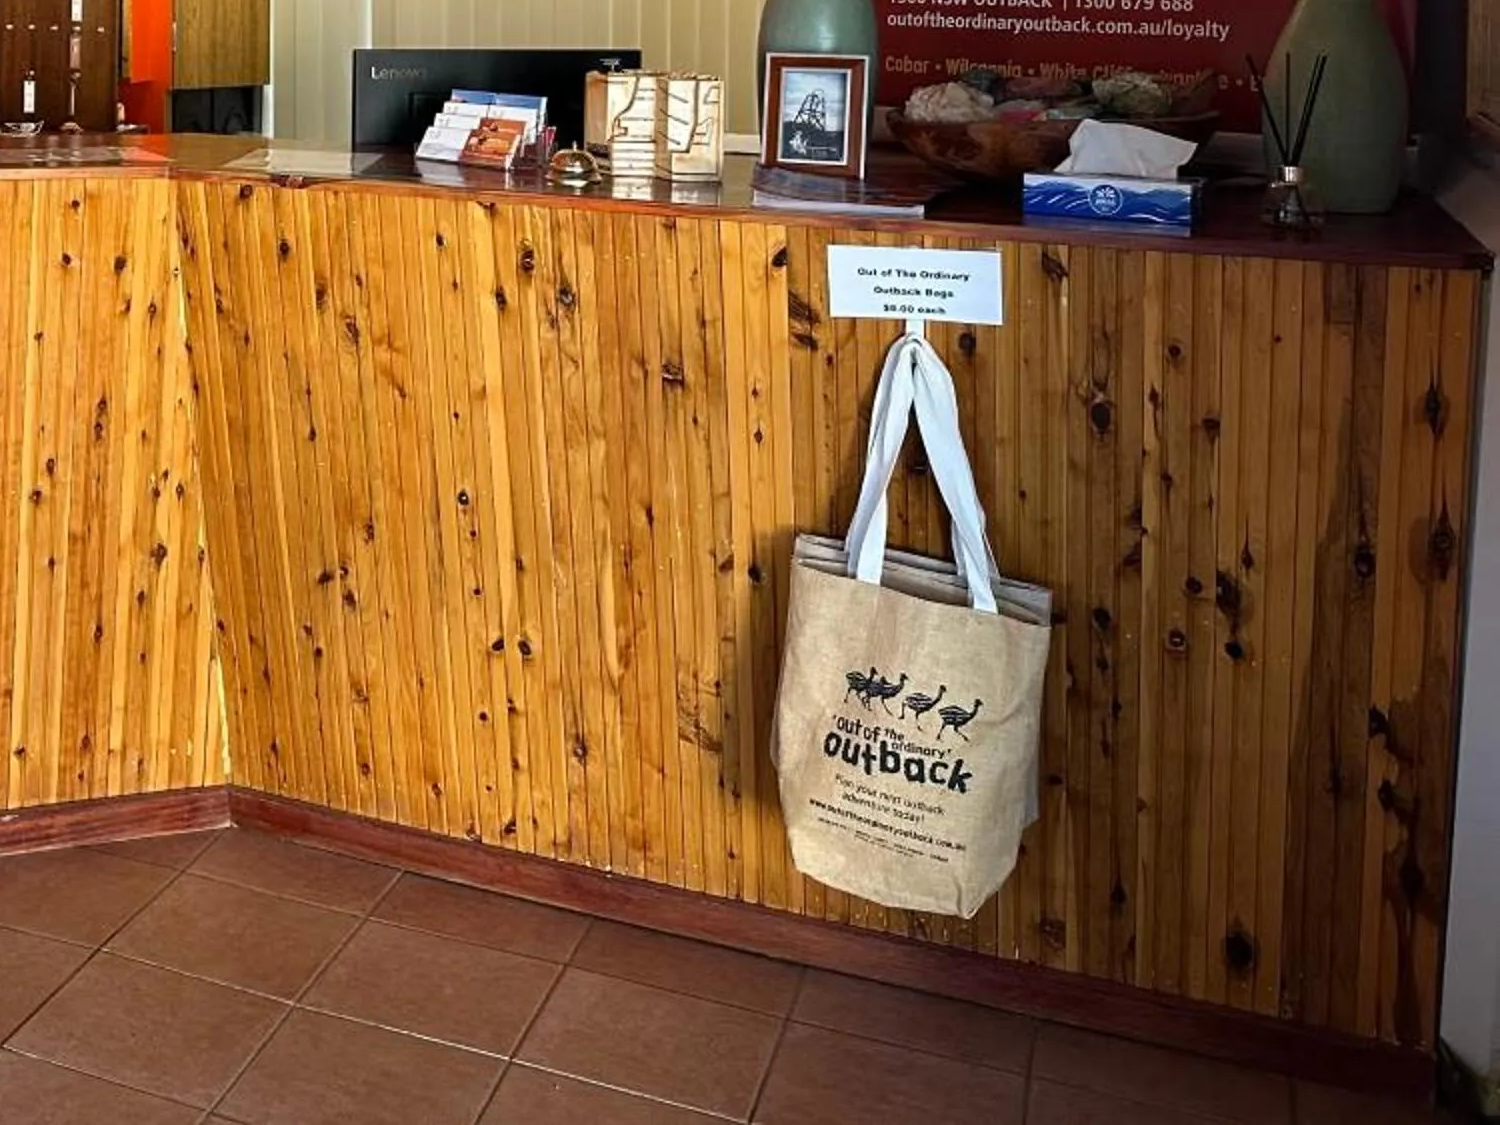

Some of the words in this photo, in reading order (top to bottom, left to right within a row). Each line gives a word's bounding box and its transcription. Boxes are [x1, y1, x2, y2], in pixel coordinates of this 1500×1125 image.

[887, 11, 1231, 43] outoftheordinaryoutback.com.au/loyalty
[885, 56, 930, 74] Cobar
[1040, 62, 1088, 81] White
[857, 267, 877, 276] Out
[880, 268, 892, 277] of
[895, 269, 916, 278] The
[919, 270, 971, 282] Ordinary
[873, 286, 921, 297] Outback
[925, 288, 954, 299] Bags
[917, 306, 946, 315] each
[863, 725, 881, 743] of
[884, 728, 905, 741] the
[823, 731, 972, 794] outback
[855, 782, 877, 797] your
[879, 791, 901, 806] next
